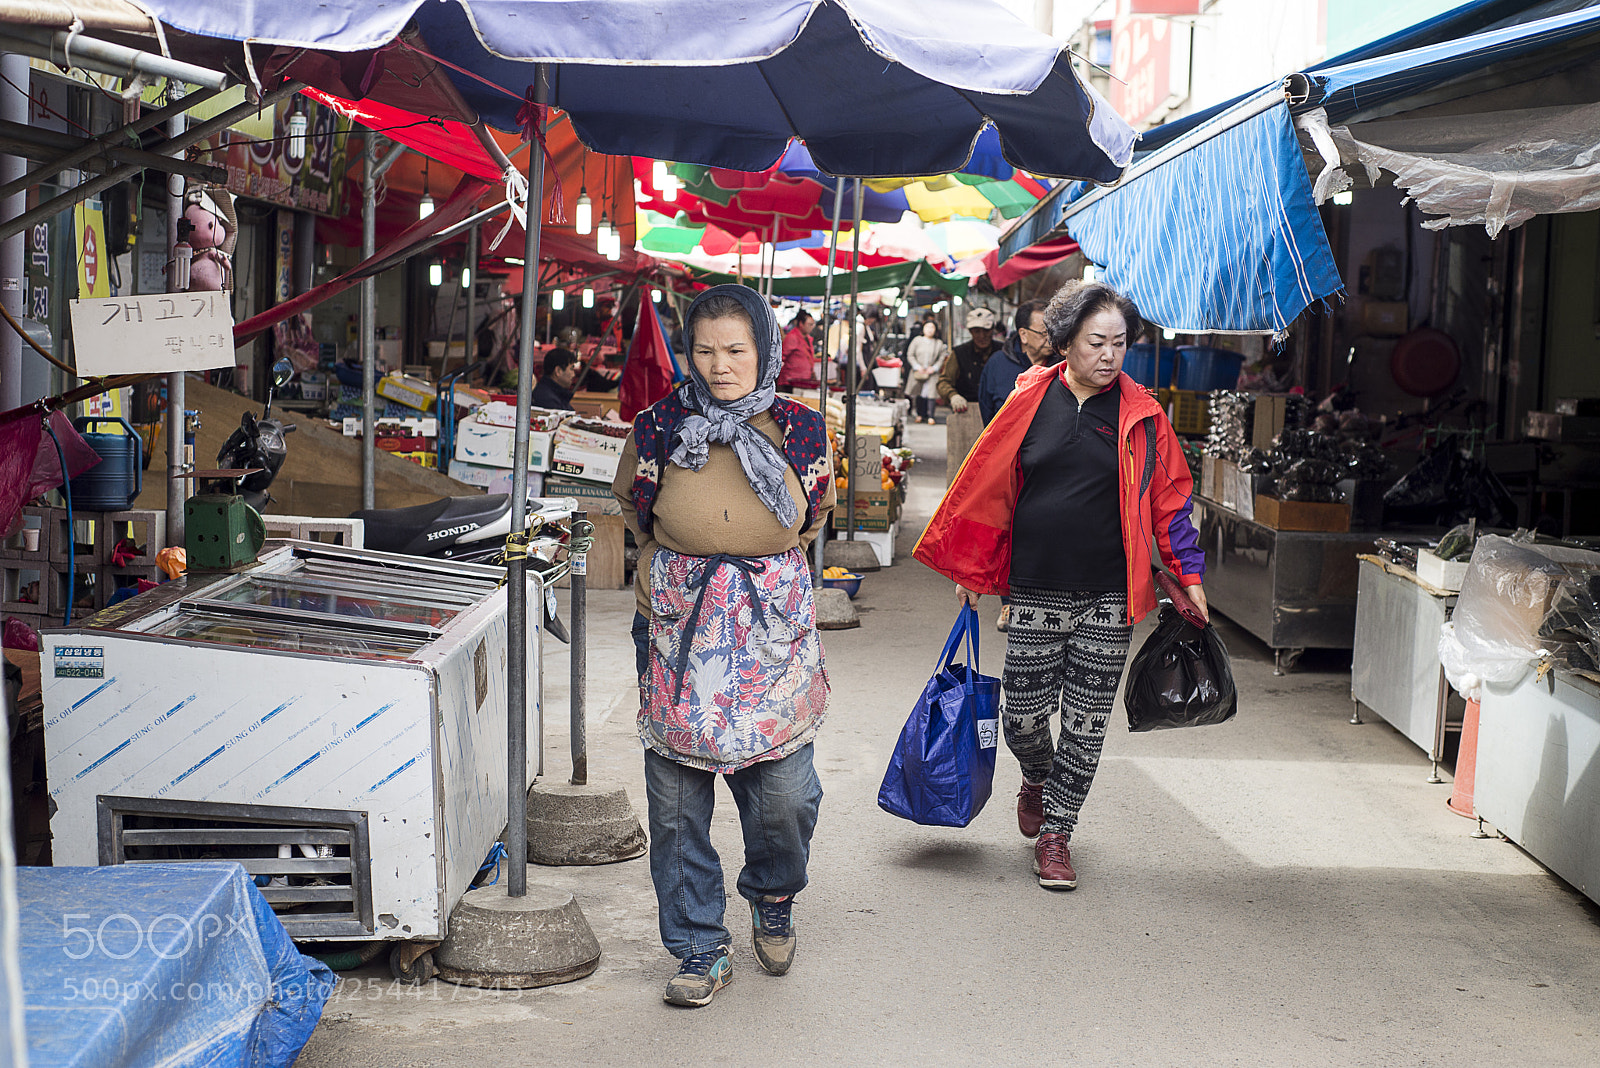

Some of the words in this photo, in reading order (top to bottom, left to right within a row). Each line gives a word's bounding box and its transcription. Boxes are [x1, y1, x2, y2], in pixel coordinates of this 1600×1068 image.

[550, 486, 581, 496] PREMIUM
[581, 489, 613, 498] BANANAS
[427, 522, 481, 541] HONDA
[59, 707, 73, 720] OH
[130, 723, 154, 743] SUNG
[154, 714, 168, 727] OH
[225, 729, 249, 749] SUNG
[248, 720, 262, 734] OH
[319, 736, 344, 756] SUNG
[343, 726, 357, 740] OH
